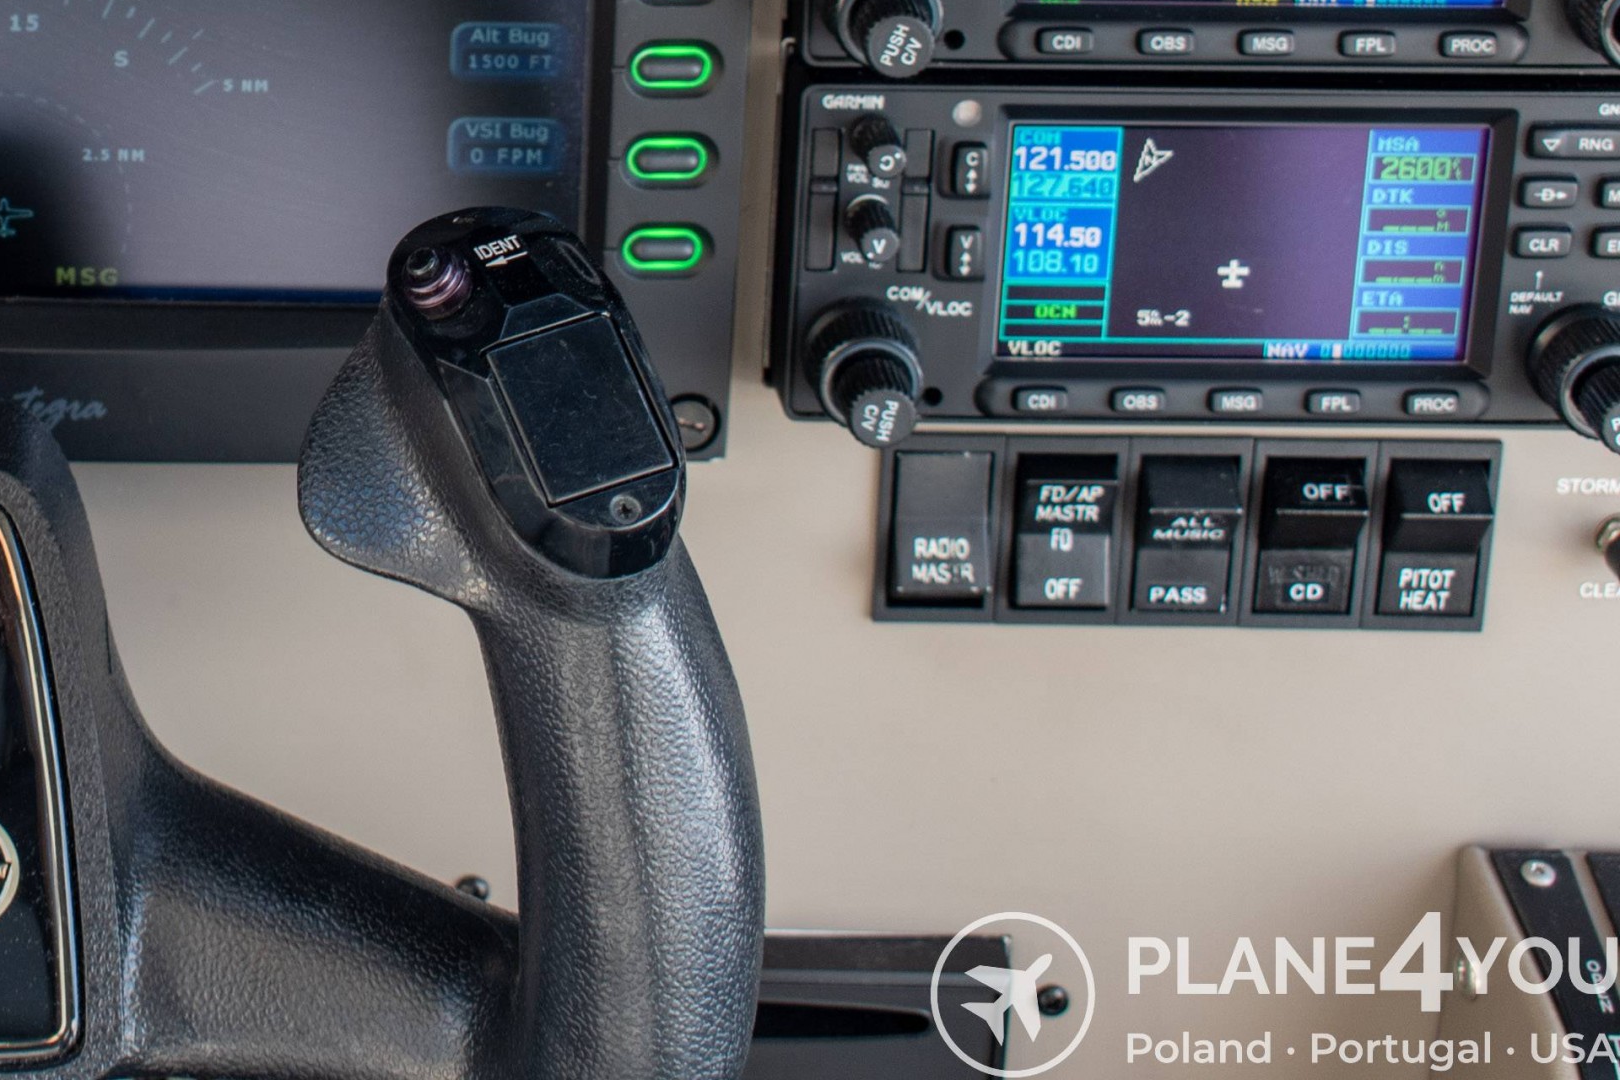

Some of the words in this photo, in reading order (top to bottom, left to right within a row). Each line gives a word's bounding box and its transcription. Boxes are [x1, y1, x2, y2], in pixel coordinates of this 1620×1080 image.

[10, 15, 39, 31] 15
[470, 29, 500, 43] Alt
[509, 29, 550, 47] Bug
[1053, 35, 1080, 49] CDI
[1151, 36, 1185, 50] OBS
[1252, 37, 1287, 51] MSG
[1356, 38, 1385, 52] FPL
[1452, 39, 1494, 53] PROC
[469, 55, 519, 69] 1500
[529, 55, 551, 69] FT
[822, 96, 884, 110] GARMIN
[466, 124, 502, 139] VSI
[511, 124, 549, 141] Bug
[1015, 147, 1116, 170] 121.500
[1372, 189, 1413, 204] DTK
[1013, 224, 1100, 246] 114.50
[474, 235, 521, 260] IDENT
[1013, 250, 1098, 273] 108.10
[56, 268, 117, 285] MSG
[1362, 291, 1402, 305] ETA
[1029, 395, 1054, 409] CDI
[1124, 395, 1157, 409] OBS
[1321, 396, 1350, 410] FPL
[1414, 397, 1455, 411] PROC
[1040, 485, 1103, 503] FD/AP
[1303, 484, 1350, 500] OFF
[1428, 494, 1466, 513] OFF
[1036, 506, 1099, 522] MASTR
[1399, 569, 1454, 588] PITOT
[1045, 579, 1082, 600] OFF
[1149, 587, 1207, 603] PASS
[1290, 584, 1323, 601] CD
[1399, 591, 1450, 611] HEAT
